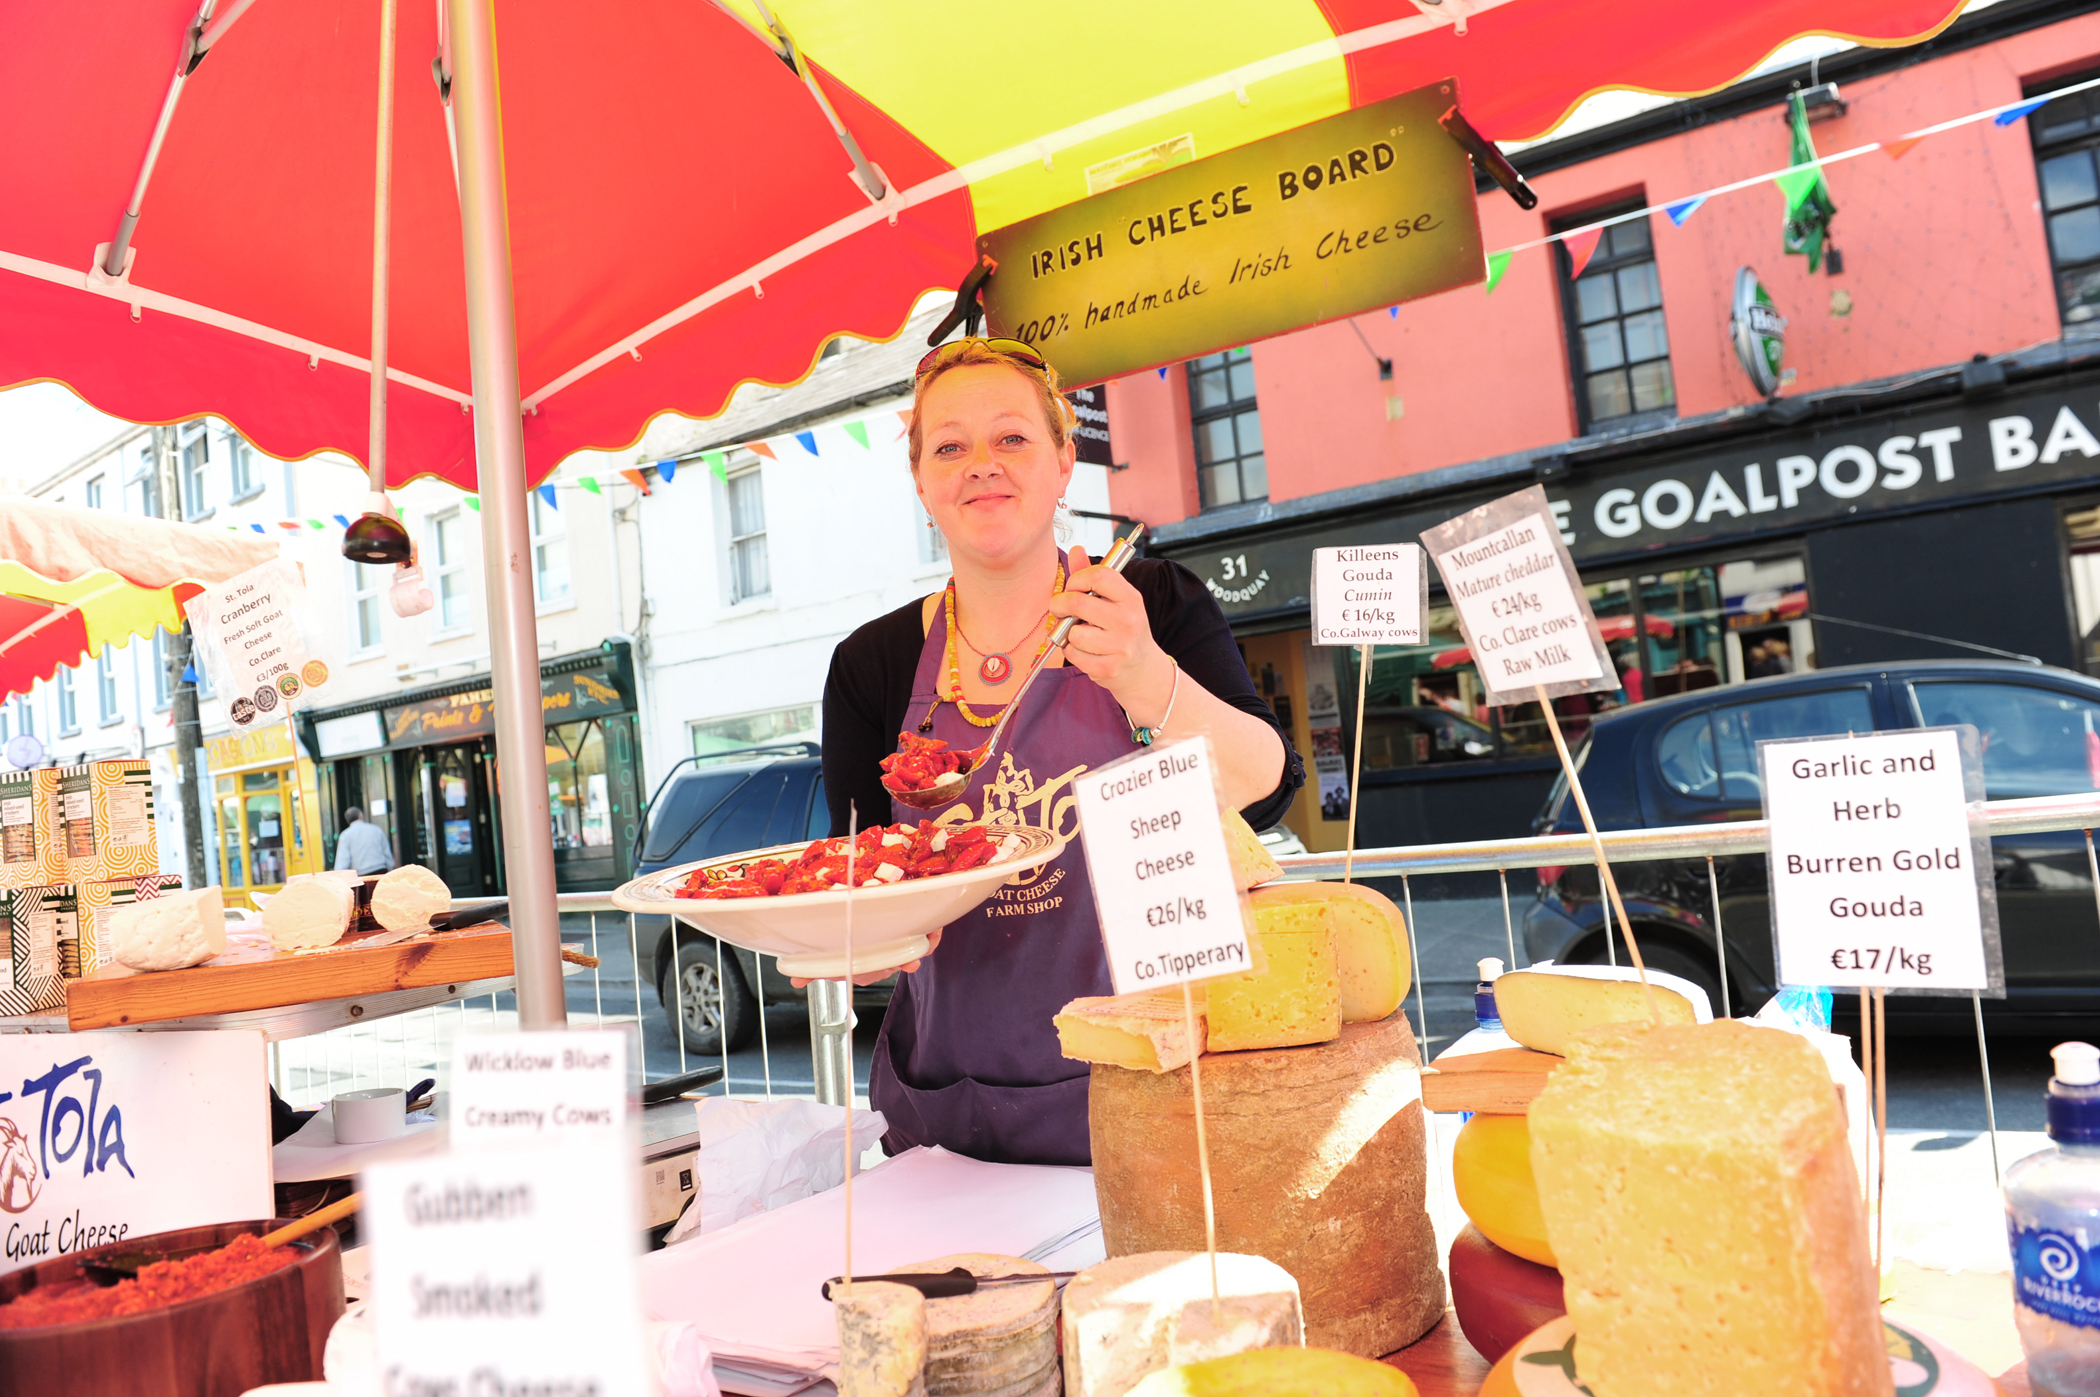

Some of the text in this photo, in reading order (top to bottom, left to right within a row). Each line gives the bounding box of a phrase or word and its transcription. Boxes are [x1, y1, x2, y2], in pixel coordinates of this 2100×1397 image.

[1031, 232, 1104, 279] IRISH
[1128, 185, 1252, 246] CHEESE
[1015, 213, 1444, 345] 100% handmade Irish Cheese
[1593, 426, 1962, 538] GOALPOST
[1988, 402, 2100, 472] BA
[1336, 548, 1399, 562] Killeens
[1451, 528, 1536, 571] Mountcallan
[1220, 553, 1248, 581] 31
[1342, 568, 1393, 582] Gouda
[1455, 553, 1556, 600] Mature cheddar
[220, 593, 272, 625] Cranberry
[224, 584, 255, 604] St. Tola
[1344, 588, 1392, 602] Cumin
[1502, 592, 1542, 616] 24/kg
[223, 609, 284, 645] Fresh Soft Goat
[1342, 608, 1396, 625] € 16/kg
[244, 630, 273, 650] Cheese
[1321, 627, 1418, 641] Co.Galway cows
[1479, 614, 1578, 652] Co. Clare cows
[248, 645, 282, 667] Co.Clare
[1502, 644, 1572, 676] Raw Milk
[256, 662, 289, 683] €3/100g
[1100, 753, 1198, 801] Crozier Blue
[1792, 749, 1936, 779] Garlic and
[1832, 797, 1902, 821] Herb
[1130, 809, 1182, 840] Sheep
[1135, 850, 1196, 881] Cheese
[1787, 847, 1961, 874] Burren Gold
[1016, 867, 1067, 902] CHEESE
[986, 896, 1064, 918] FARM SHOP
[1146, 898, 1208, 928] €26/kg
[1829, 895, 1924, 918] Gouda
[1135, 942, 1245, 981] Co.Tipperary
[1830, 945, 1933, 976] €17/kg
[465, 1048, 612, 1072] Wicklow Blue
[464, 1102, 613, 1131] Creamy Cows
[6, 1208, 129, 1263] Goat Cheese
[410, 1268, 545, 1320] Smoked
